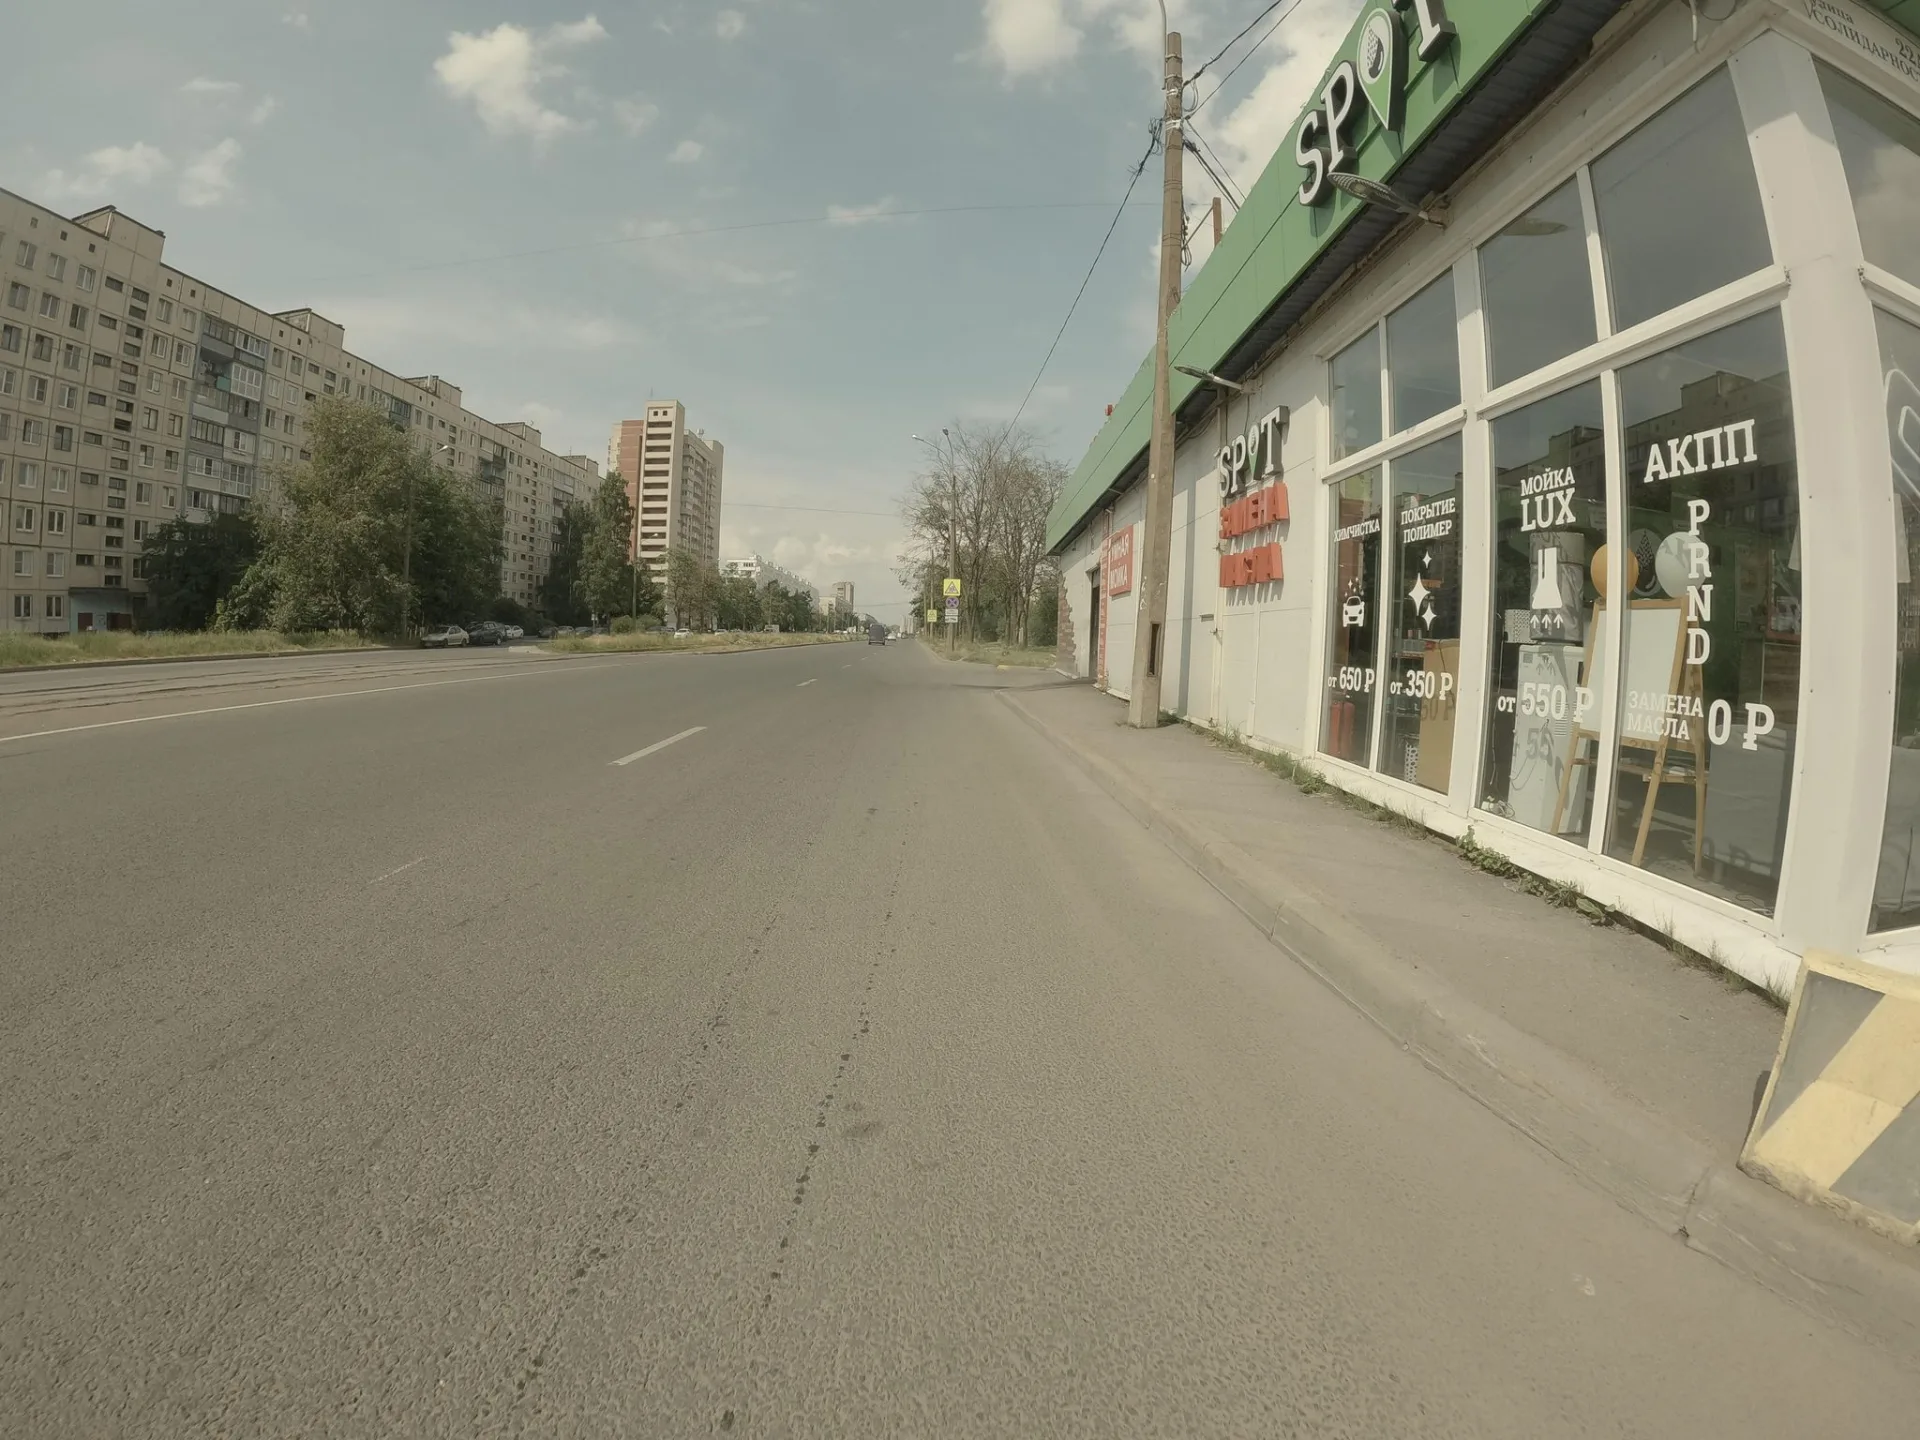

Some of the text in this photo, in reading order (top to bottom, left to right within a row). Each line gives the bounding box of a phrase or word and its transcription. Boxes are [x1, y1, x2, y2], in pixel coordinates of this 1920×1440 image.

[1644, 419, 1758, 483] АКПП
[1521, 466, 1576, 497] МОЙКА
[1401, 497, 1456, 525] ПОКРЫТИЕ
[1521, 487, 1576, 532] LUX
[1334, 518, 1380, 542] ХИМЧИСТКА
[1403, 519, 1453, 543] ПОЛИМЕР
[1339, 666, 1362, 691] 650
[1405, 669, 1436, 699] 350
[1521, 682, 1567, 721] 550
[1628, 690, 1704, 719] ЗАМЕНА
[1626, 712, 1691, 741] МАСЛА
[1707, 699, 1732, 745] 0
